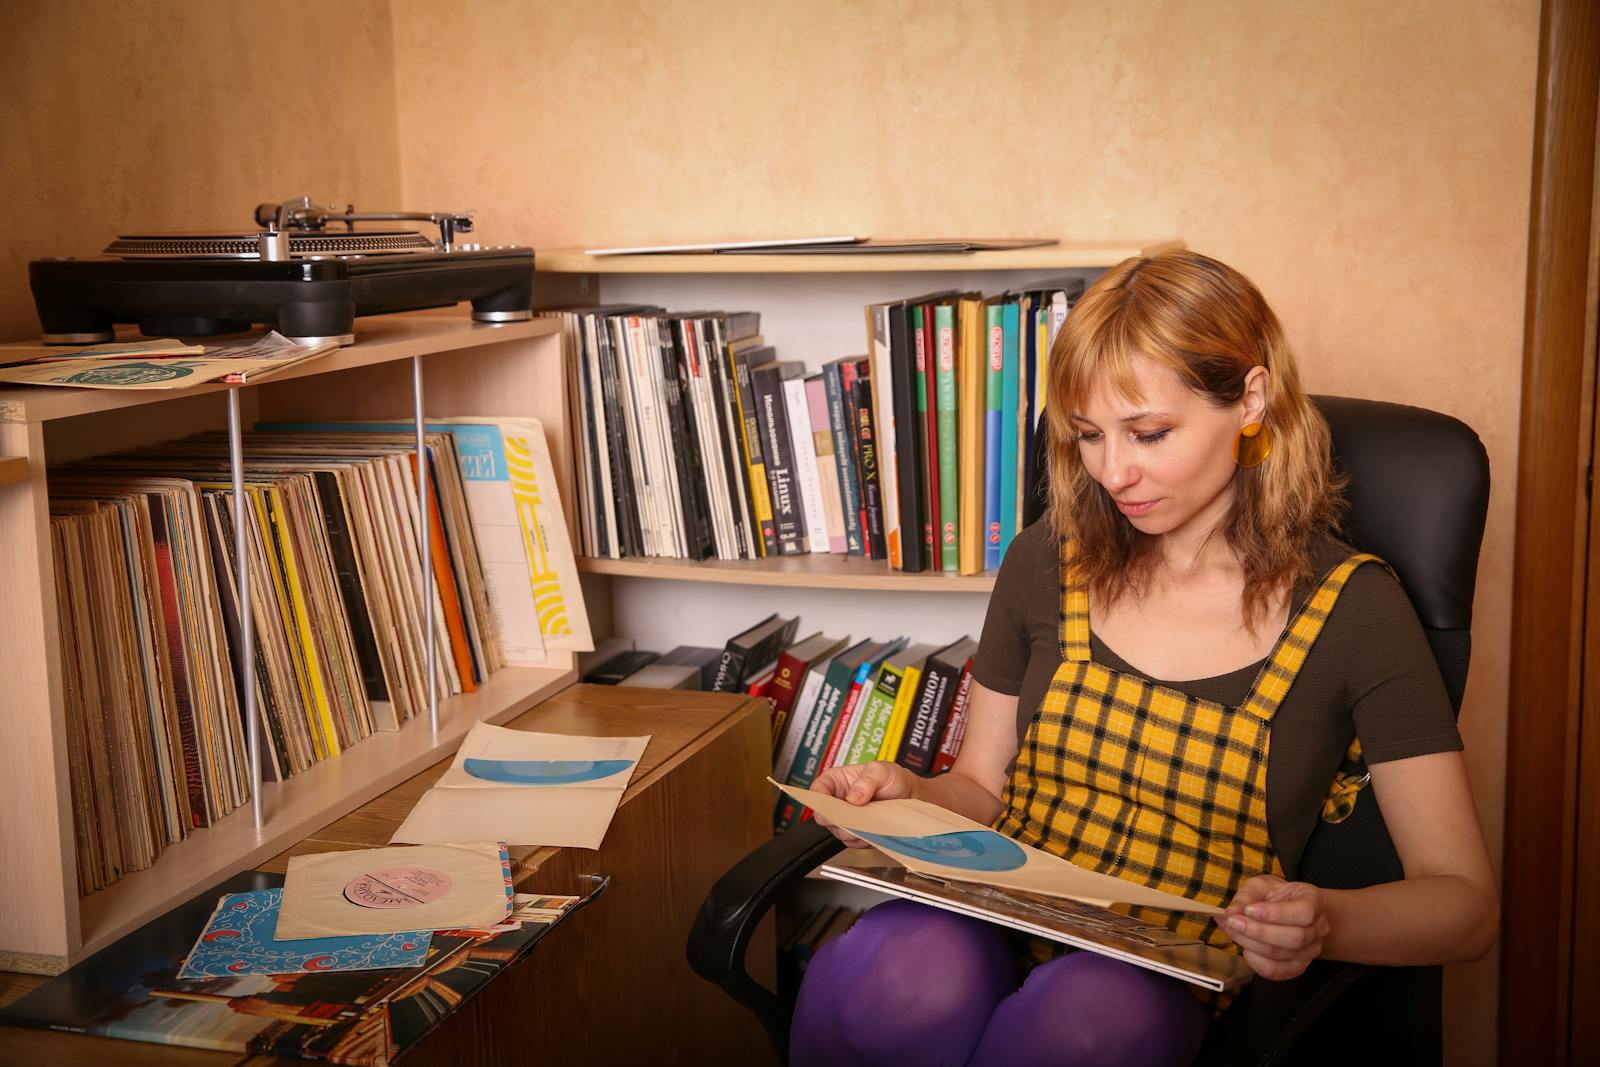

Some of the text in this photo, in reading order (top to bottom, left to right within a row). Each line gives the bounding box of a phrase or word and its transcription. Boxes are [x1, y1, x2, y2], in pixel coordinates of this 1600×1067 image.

[830, 400, 841, 430] Windows
[763, 394, 780, 466] Использование
[776, 467, 794, 514] Linux
[862, 443, 875, 469] PRO
[865, 471, 875, 480] X
[862, 696, 883, 731] Snow
[865, 701, 893, 756] Mac OS X
[909, 670, 940, 747] PHOTOSHOP
[940, 711, 961, 754] Photoshop
[953, 694, 965, 712] LAB
